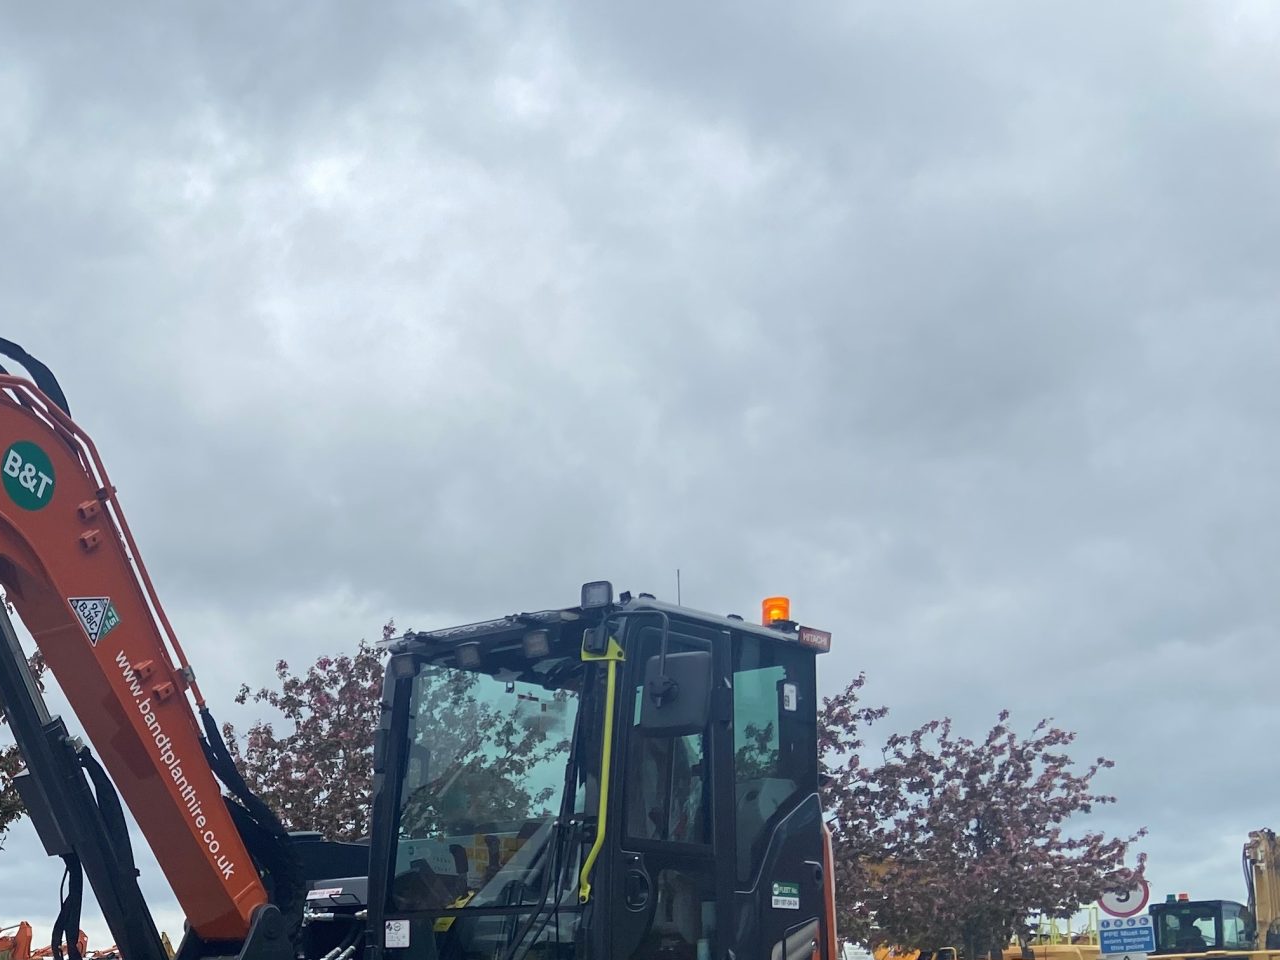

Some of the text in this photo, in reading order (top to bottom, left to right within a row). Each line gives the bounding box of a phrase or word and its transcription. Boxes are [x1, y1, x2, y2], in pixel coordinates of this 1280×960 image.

[3, 449, 53, 498] B&T
[79, 602, 97, 630] BJ8C
[90, 603, 101, 617] 94
[114, 650, 235, 880] www.bandtplanthire.co.uk
